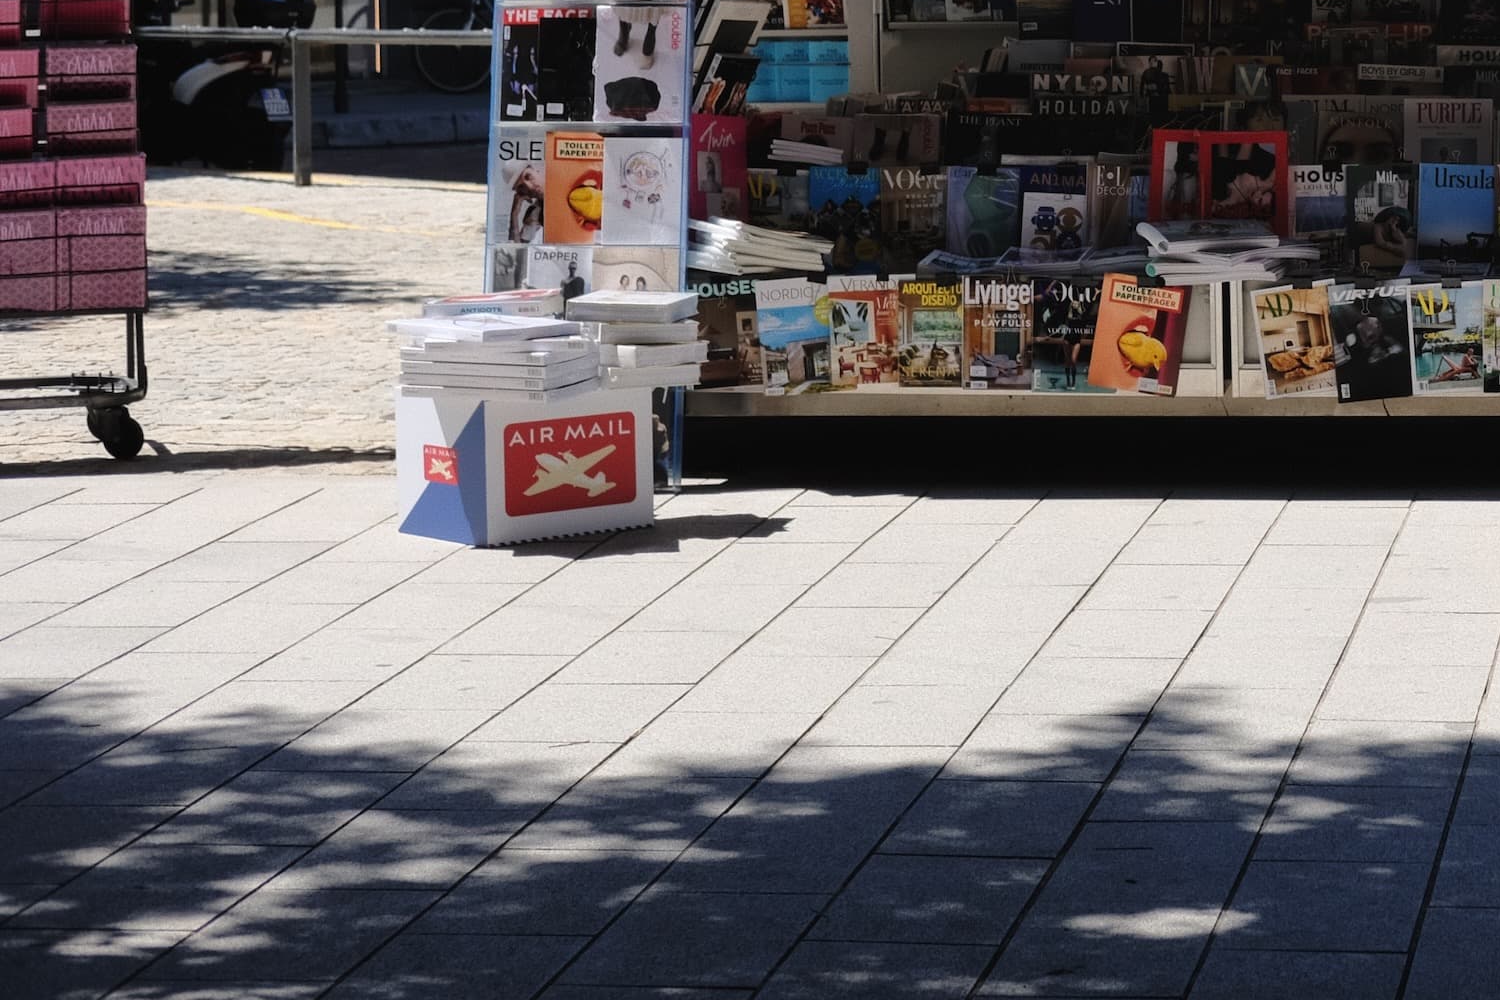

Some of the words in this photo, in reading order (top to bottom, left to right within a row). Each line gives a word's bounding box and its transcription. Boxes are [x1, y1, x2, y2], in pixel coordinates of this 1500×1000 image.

[505, 9, 538, 22] THE
[1032, 73, 1130, 93] NYLON
[1039, 100, 1130, 116] HOLIDAY
[1416, 101, 1483, 125] PURPLE
[1434, 166, 1496, 190] Ursula
[509, 426, 554, 447] AIR
[564, 418, 631, 441] MAIL
[424, 447, 438, 456] AIR
[438, 449, 457, 458] MAIL
